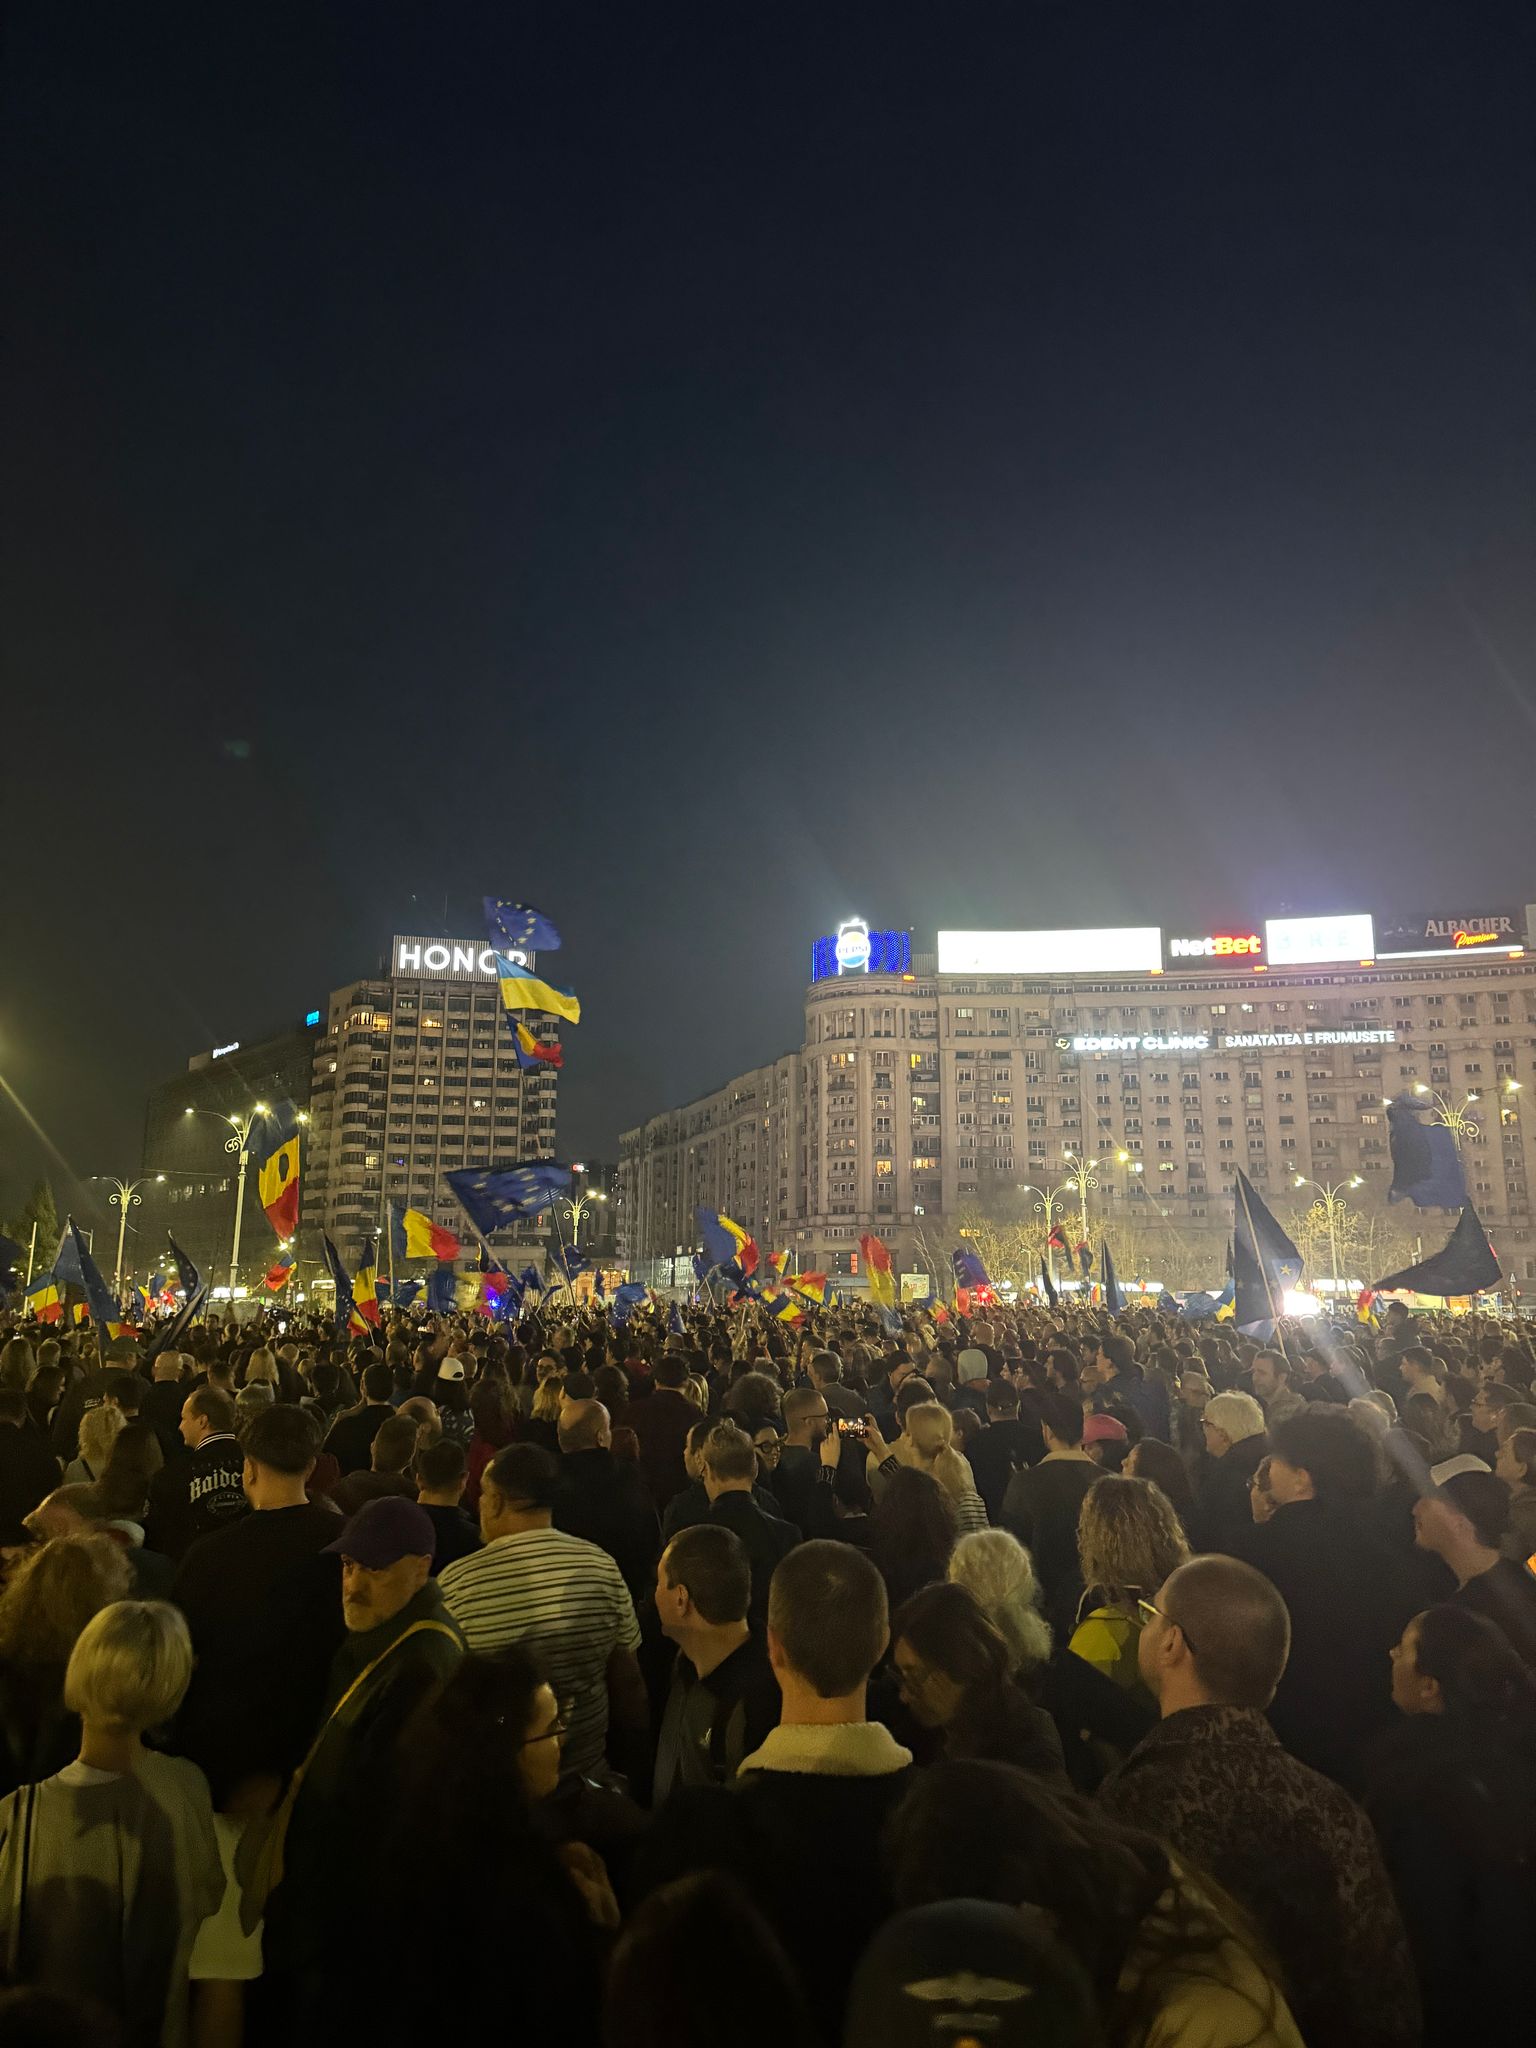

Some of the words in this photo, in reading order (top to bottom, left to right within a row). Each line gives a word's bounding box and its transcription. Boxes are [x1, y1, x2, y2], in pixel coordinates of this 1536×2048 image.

[1425, 916, 1515, 937] ALBACHER
[1171, 935, 1262, 957] NetBet
[1453, 930, 1499, 949] Premium
[1142, 1035, 1209, 1050] CLINIC
[1303, 1032, 1314, 1045] E
[189, 1467, 242, 1504] Raide
